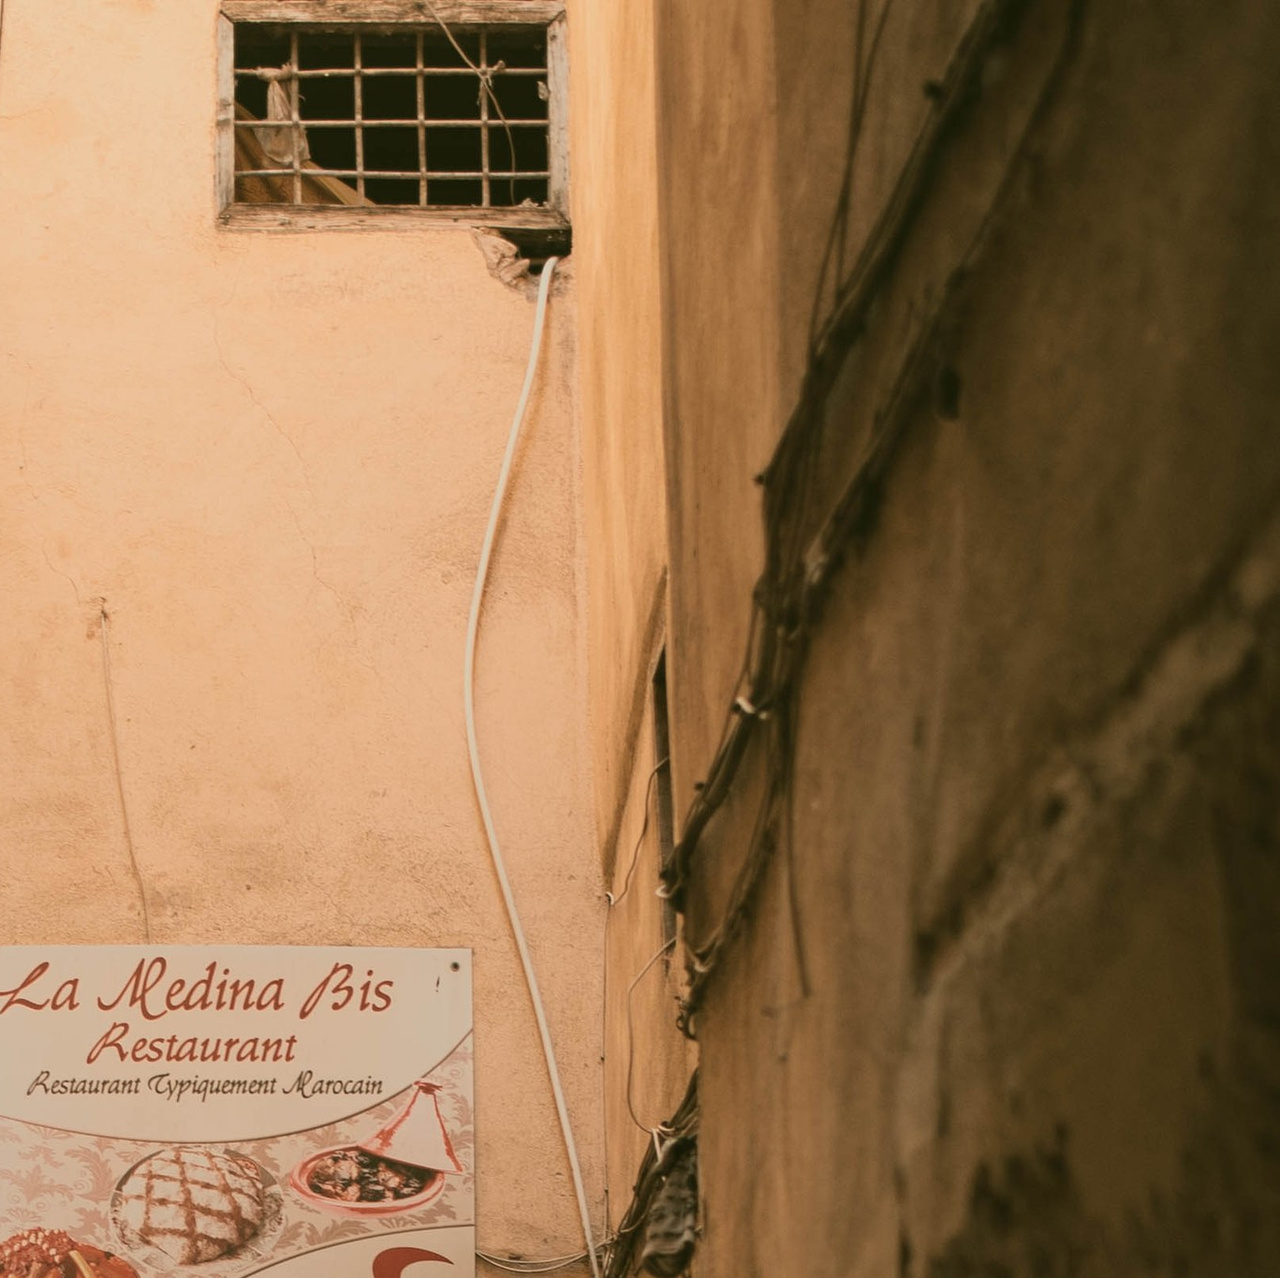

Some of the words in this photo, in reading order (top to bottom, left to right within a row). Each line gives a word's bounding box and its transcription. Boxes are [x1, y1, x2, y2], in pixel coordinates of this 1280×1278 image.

[97, 956, 285, 1020] Medina
[299, 962, 394, 1020] Bis
[86, 1022, 298, 1064] Restaurant
[26, 1070, 140, 1096] Restaurant
[147, 1073, 277, 1103] Typiquement
[282, 1070, 383, 1099] Marocain
